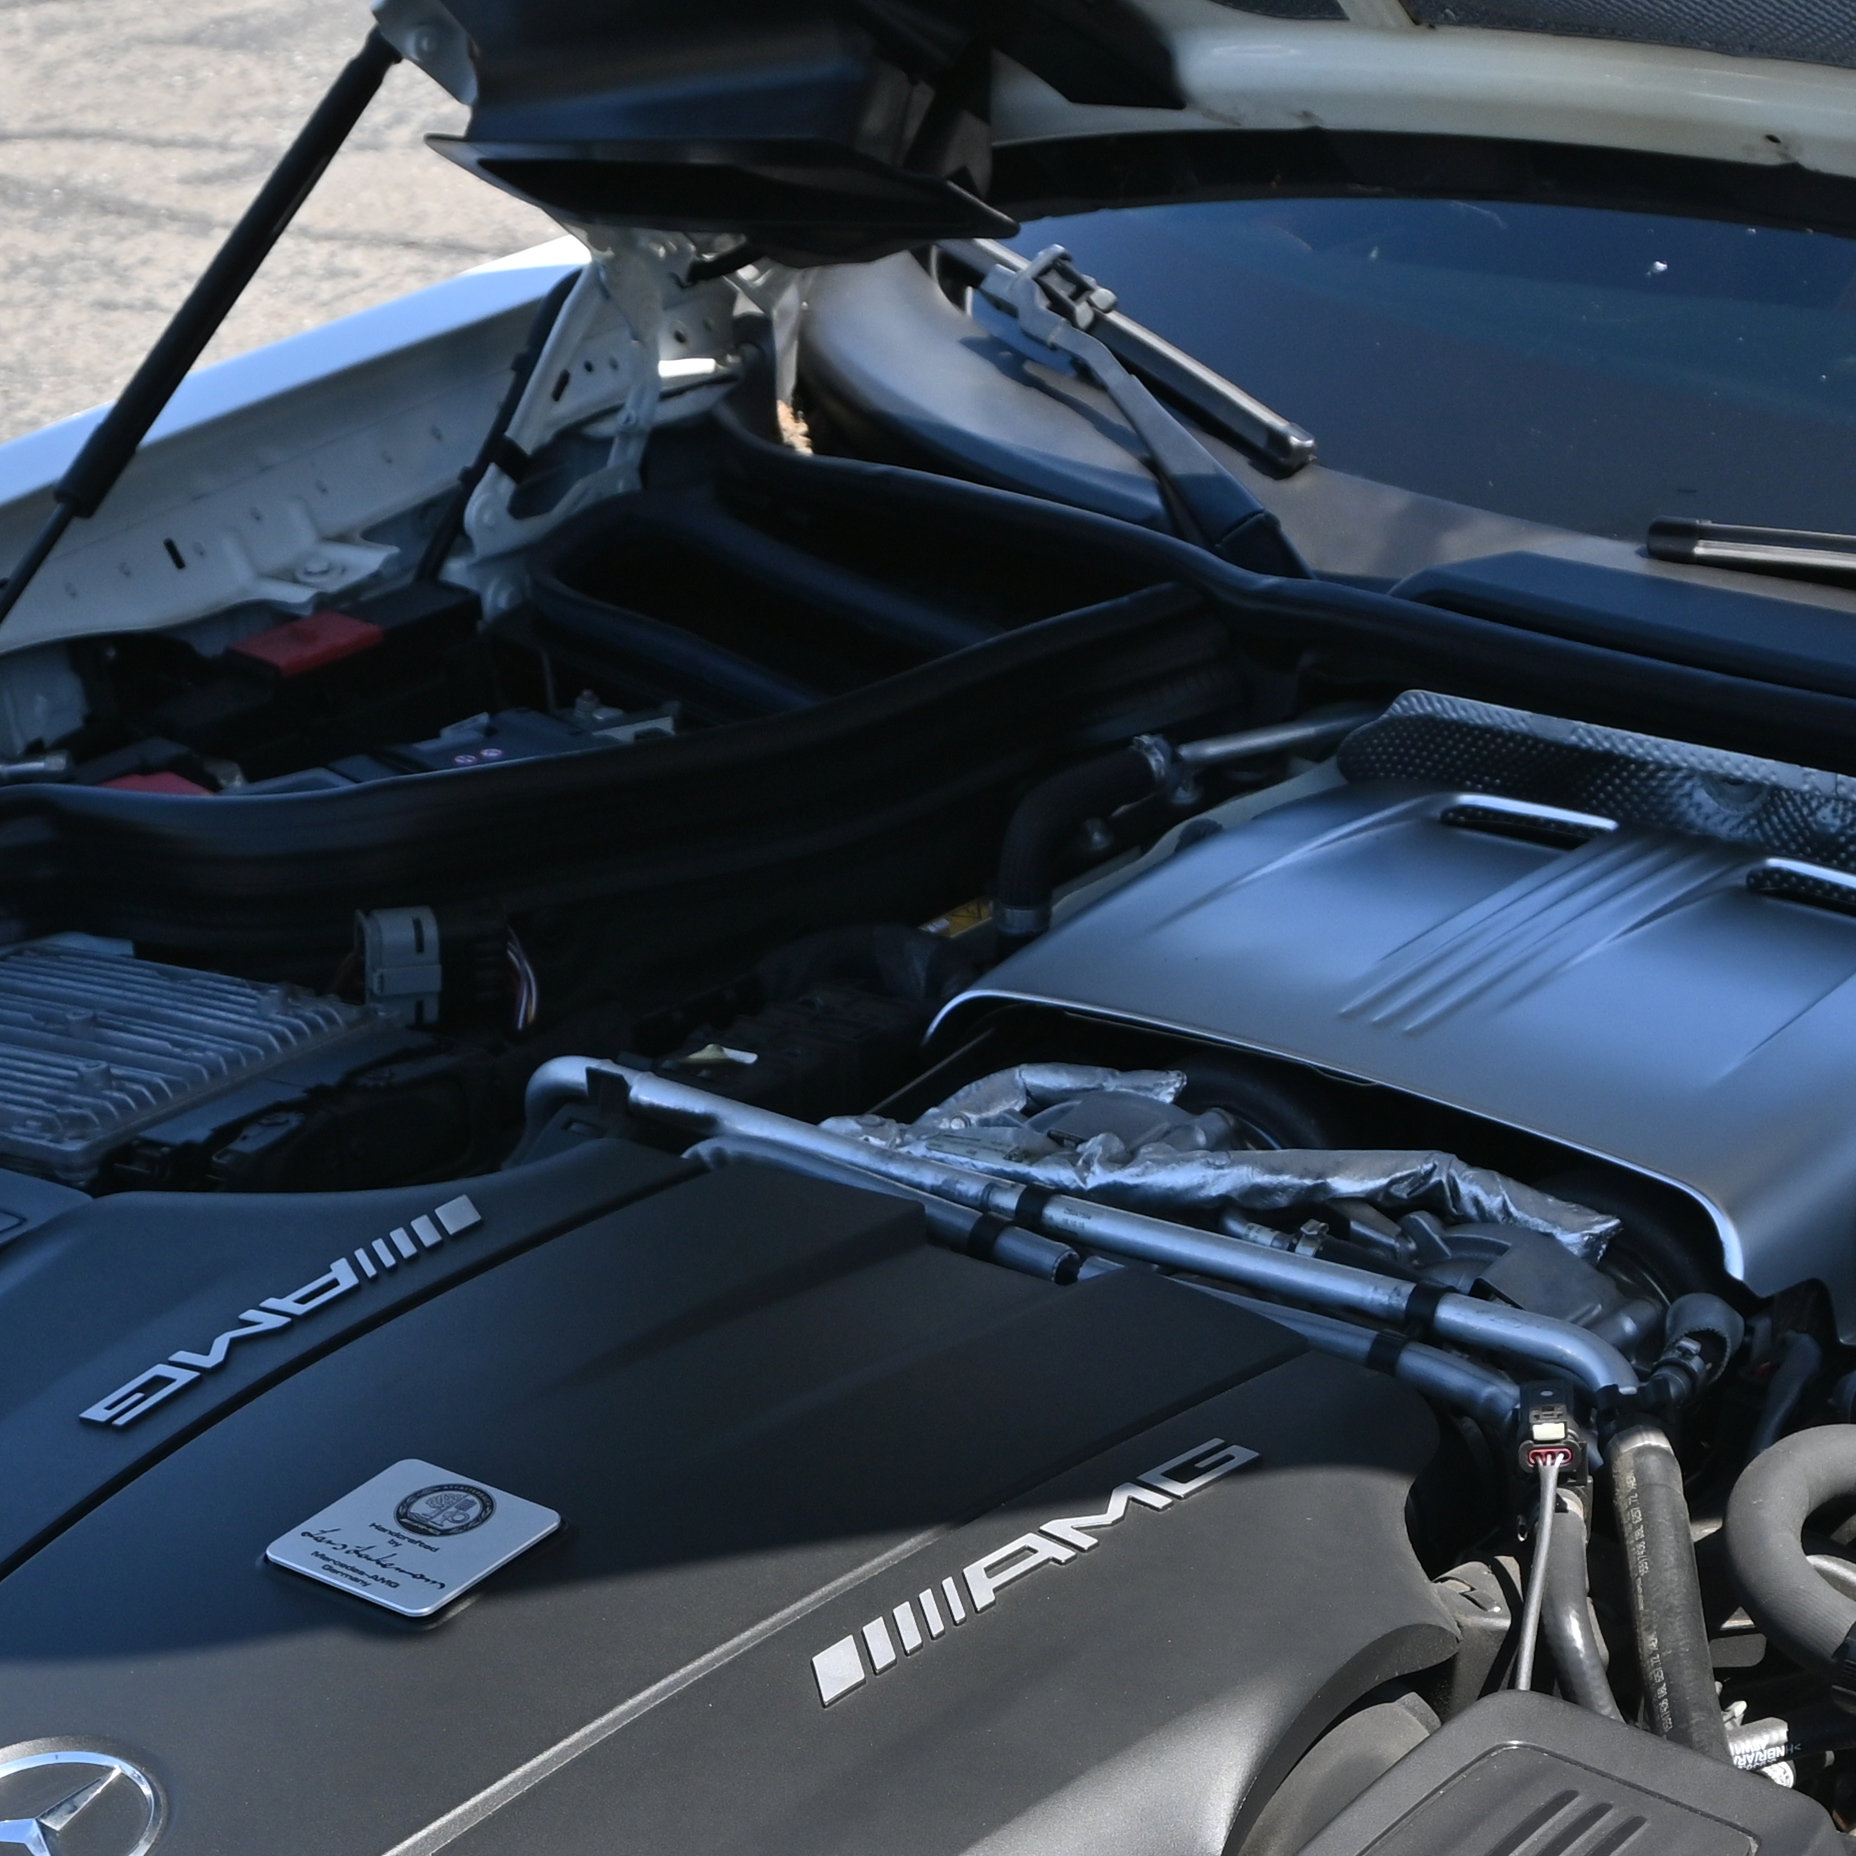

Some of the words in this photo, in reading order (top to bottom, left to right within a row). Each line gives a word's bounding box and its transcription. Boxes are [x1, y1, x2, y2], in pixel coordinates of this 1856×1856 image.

[78, 1255, 360, 1428] AMG
[369, 1521, 441, 1553] Handcrafted
[969, 1436, 1262, 1612] AMG
[388, 1538, 403, 1548] by
[310, 1550, 400, 1589] Mercedes-AMG
[320, 1564, 373, 1588] Germany
